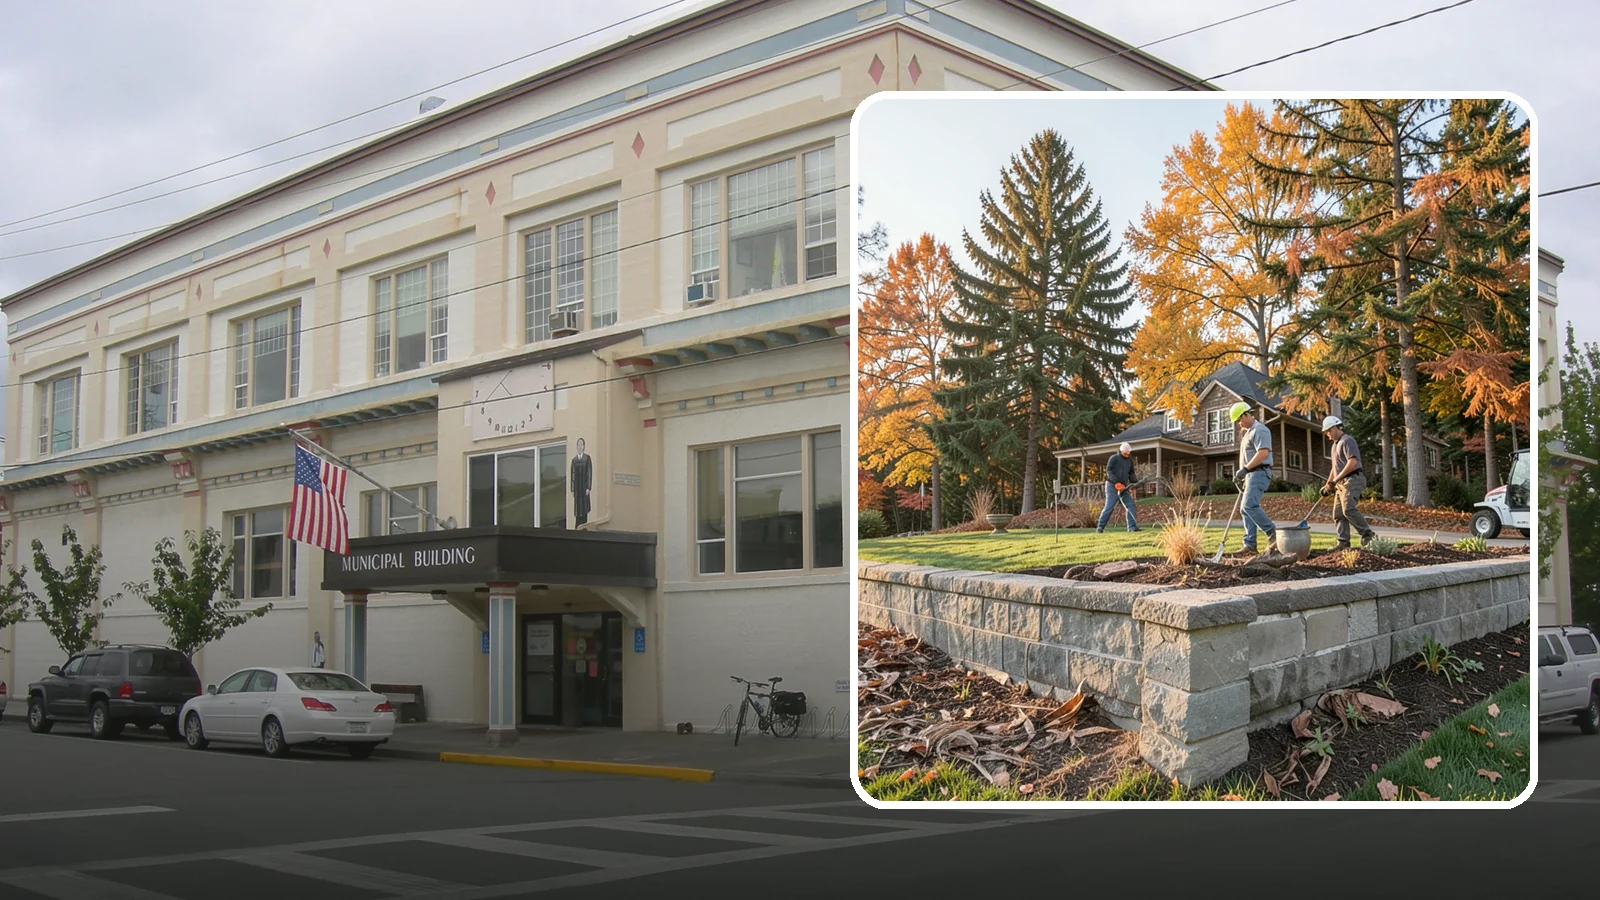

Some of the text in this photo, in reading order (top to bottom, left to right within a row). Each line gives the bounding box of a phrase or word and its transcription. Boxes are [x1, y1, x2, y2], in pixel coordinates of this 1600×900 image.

[546, 362, 551, 370] 6
[475, 390, 479, 398] 7
[536, 402, 540, 410] 4
[480, 407, 485, 415] 8
[488, 417, 492, 426] 9
[529, 414, 533, 422] 3
[495, 424, 500, 432] 10
[521, 420, 526, 428] 2
[501, 425, 506, 433] 11
[507, 425, 513, 433] 12
[342, 546, 476, 572] MUNICIPAL BUILDING
